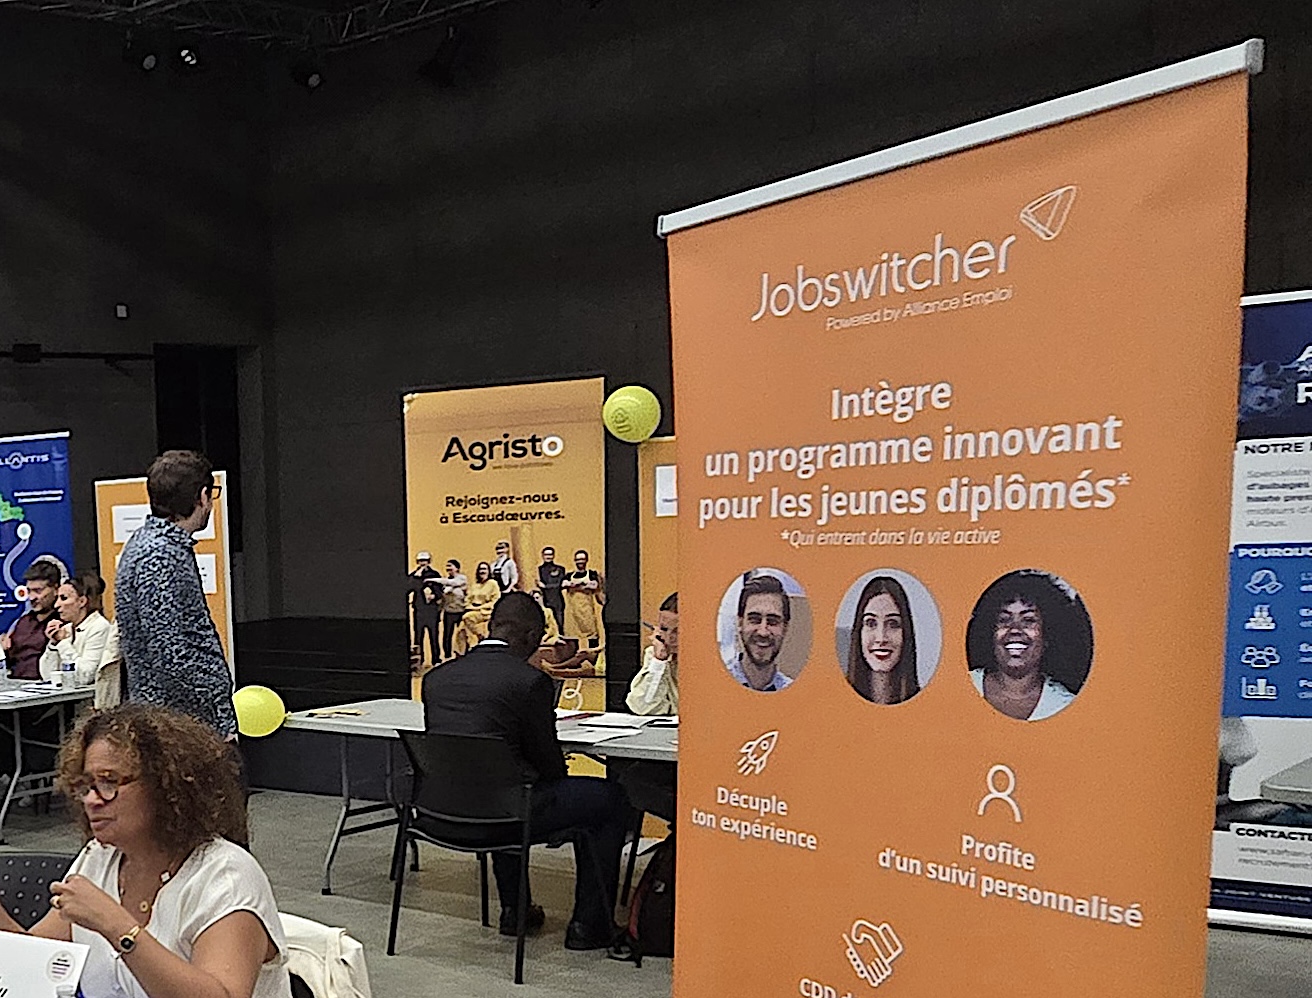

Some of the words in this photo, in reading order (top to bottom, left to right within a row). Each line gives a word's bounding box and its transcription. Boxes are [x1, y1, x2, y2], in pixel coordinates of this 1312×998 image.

[751, 232, 1017, 322] Jobswitcher
[825, 310, 881, 331] Powered
[883, 305, 901, 322] by
[902, 297, 960, 318] Alliance
[962, 285, 1014, 309] Emploi
[830, 380, 952, 423] Intègre
[441, 432, 564, 471] Agristo
[705, 450, 739, 478] un
[748, 434, 933, 482] programme
[943, 415, 1124, 462] innovant
[1244, 441, 1305, 455] NOTRE
[439, 513, 448, 524] à
[452, 510, 565, 524] Escaudœuvres.
[445, 493, 559, 510] Rejoignez-nous
[699, 494, 762, 529] pour
[770, 487, 813, 519] les
[817, 485, 927, 526] jeunes
[816, 530, 867, 546] entrent
[868, 528, 905, 546] dans
[908, 527, 924, 545] la
[927, 528, 950, 545] vie
[953, 527, 1001, 545] active
[716, 786, 788, 817] Décuple
[691, 807, 717, 829] ton
[719, 816, 817, 850] expérience
[961, 835, 1035, 871] Profite
[878, 848, 922, 876] d'un
[926, 860, 976, 889] suivi
[980, 872, 1144, 928] personnalisé
